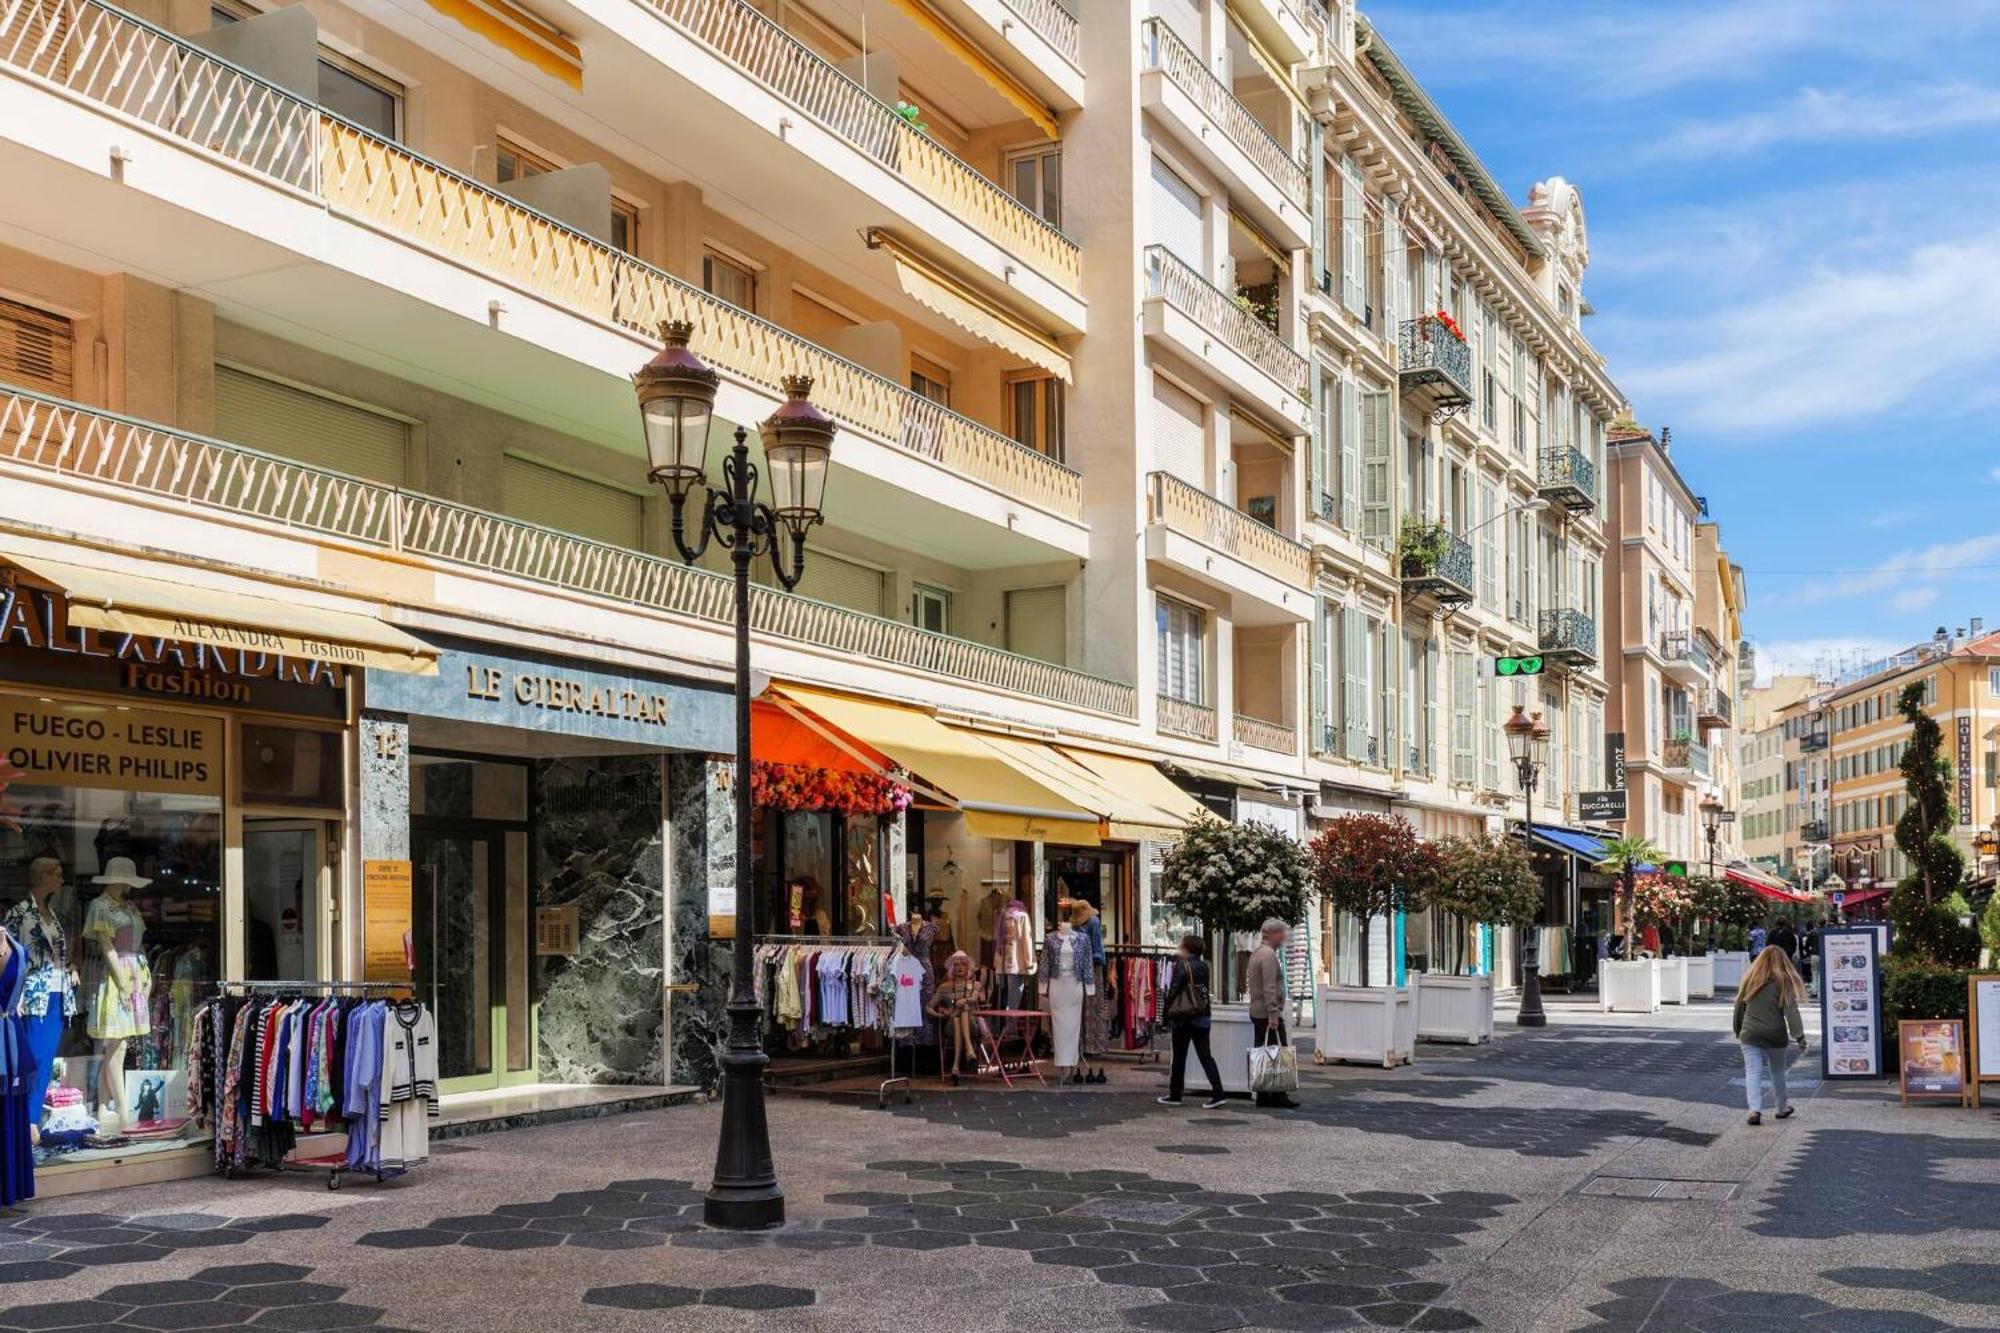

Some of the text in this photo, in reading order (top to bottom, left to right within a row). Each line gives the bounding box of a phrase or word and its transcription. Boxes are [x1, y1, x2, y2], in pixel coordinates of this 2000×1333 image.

[173, 619, 366, 662] ALEXANDRA Fashion
[127, 663, 251, 702] Fashion
[467, 664, 667, 726] LE GIBRALTAR
[13, 712, 106, 741] FUEGO
[127, 723, 204, 750] LESLIE
[1959, 717, 1970, 761] HOTEL
[8, 747, 209, 782] OLIVIER PHILIPS
[1581, 802, 1625, 810] ZUCCARELLI
